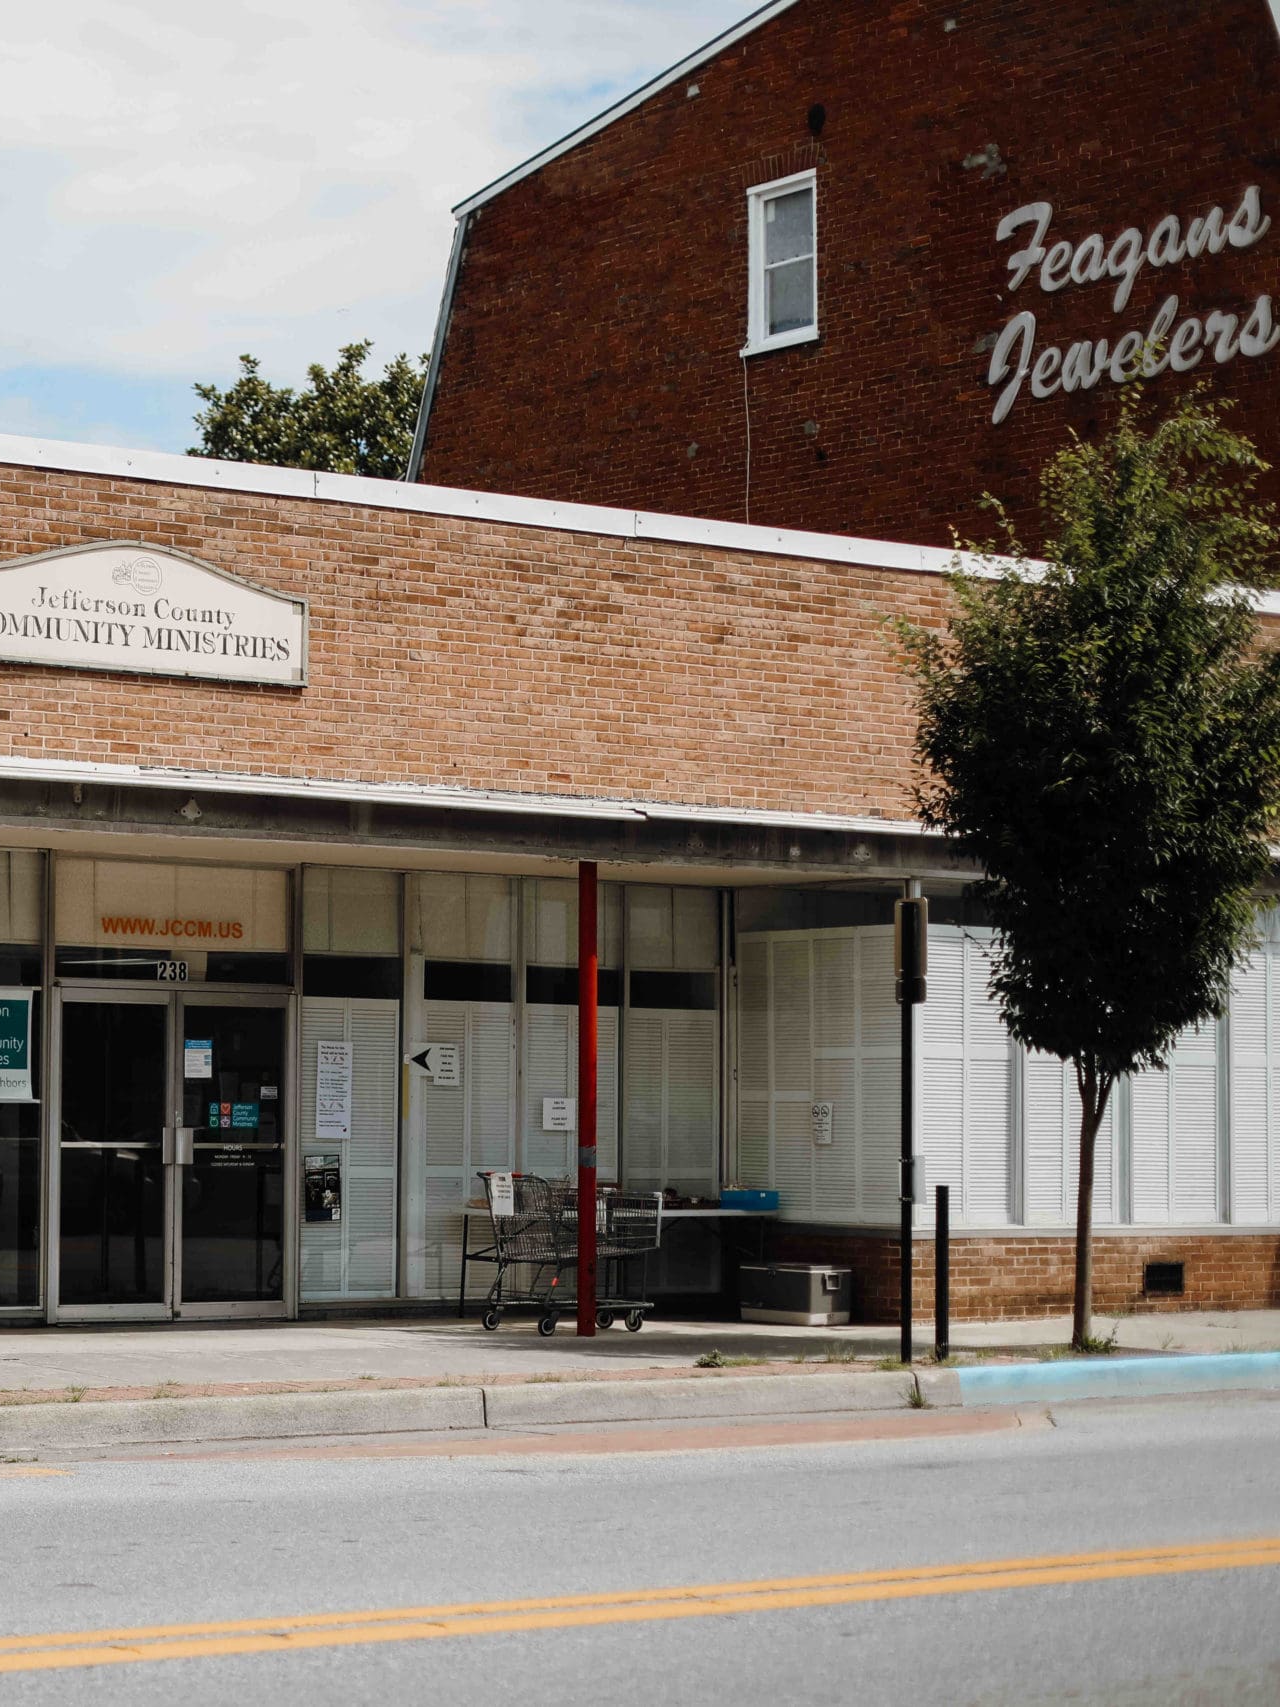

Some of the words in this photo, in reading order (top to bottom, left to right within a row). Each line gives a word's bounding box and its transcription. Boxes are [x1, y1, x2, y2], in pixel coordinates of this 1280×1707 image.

[996, 185, 1272, 313] Feagans
[988, 294, 1280, 425] Jewelers
[31, 586, 147, 617] Jefferson
[153, 598, 237, 630] County
[141, 626, 291, 661] MINISTRIES
[101, 917, 243, 939] WWW.JCCM.US
[158, 961, 187, 981] 238
